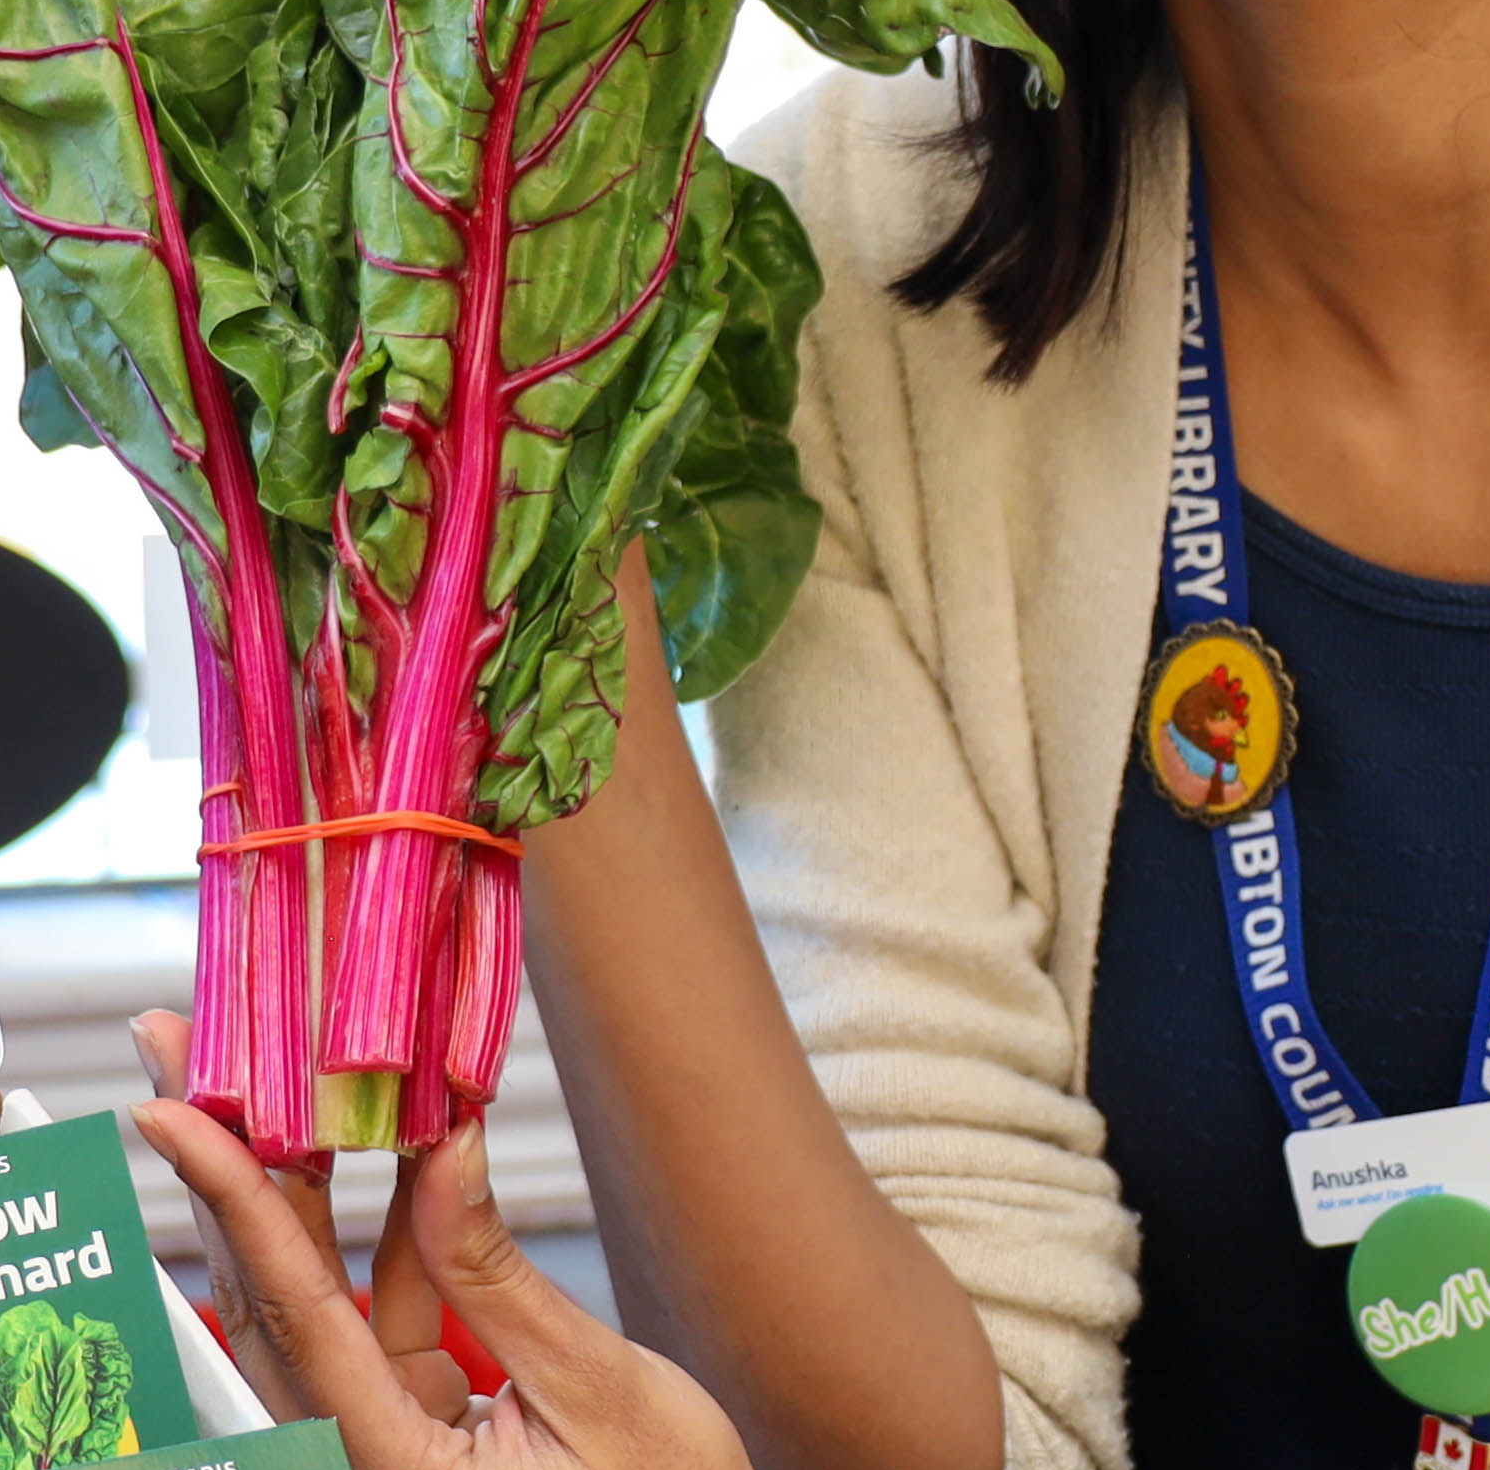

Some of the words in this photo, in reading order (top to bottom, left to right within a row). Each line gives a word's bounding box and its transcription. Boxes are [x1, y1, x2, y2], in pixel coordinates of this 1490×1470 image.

[1226, 809, 1290, 993] BTON
[1260, 1002, 1359, 1131] COUN
[1310, 1159, 1409, 1191] Anushka
